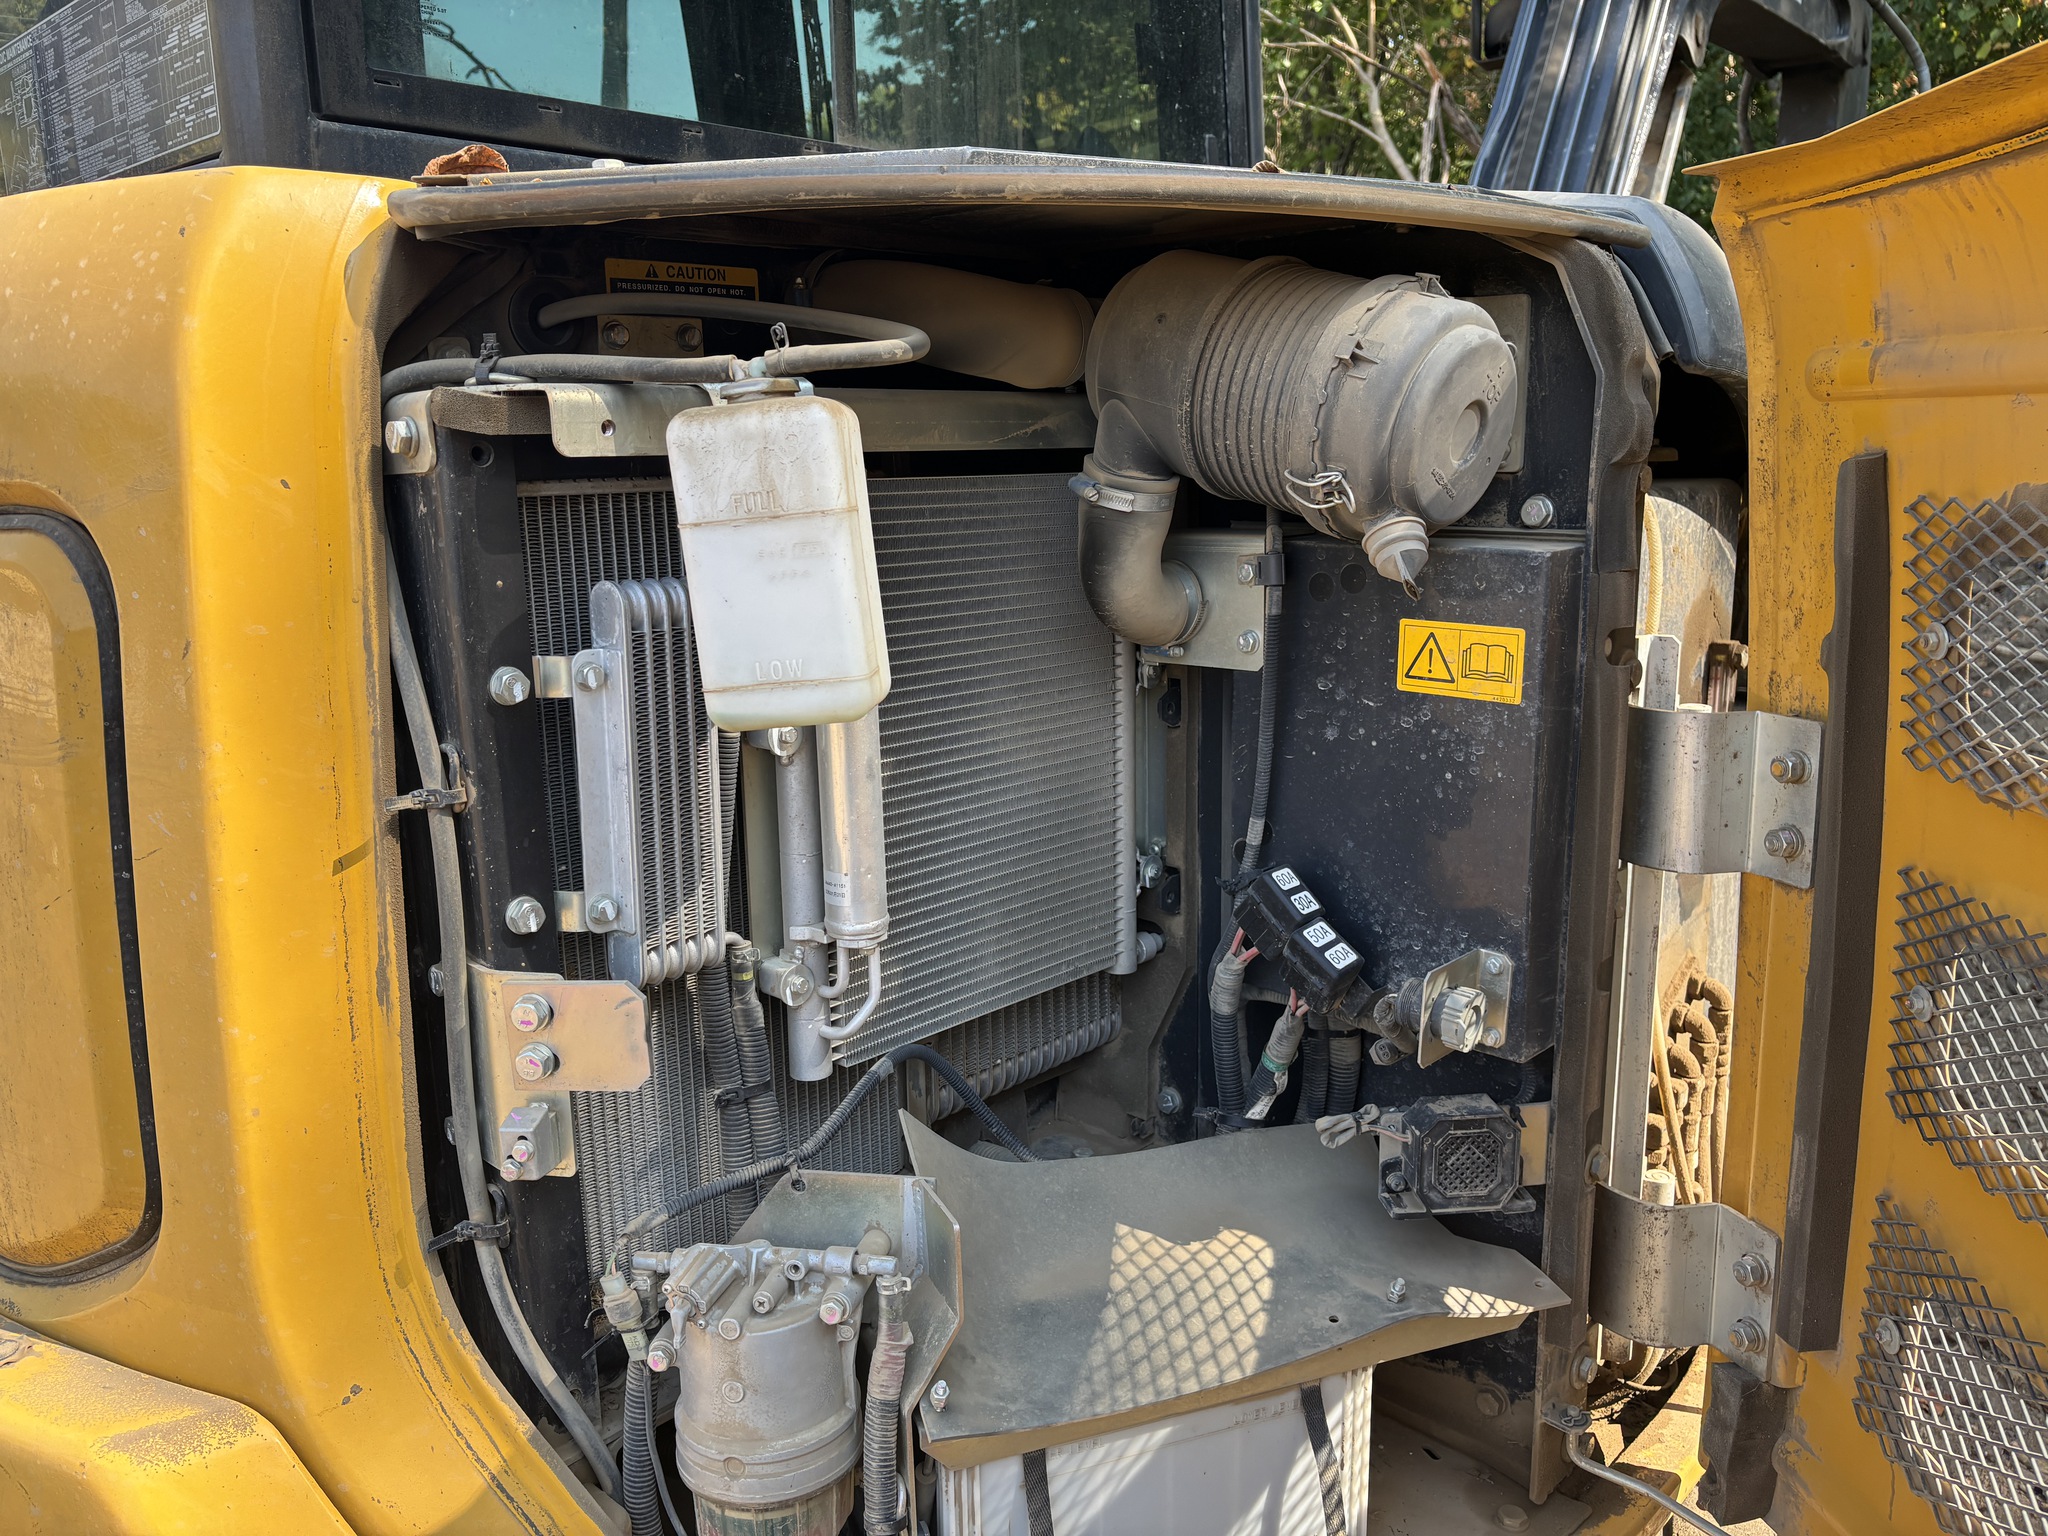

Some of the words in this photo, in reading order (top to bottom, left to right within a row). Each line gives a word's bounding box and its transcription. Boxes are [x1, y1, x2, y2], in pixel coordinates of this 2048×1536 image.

[666, 264, 726, 282] CAUTION
[617, 282, 671, 292] PRESSURIZED.
[675, 285, 686, 293] DO
[689, 286, 703, 294] NOT
[707, 287, 726, 295] OPEN
[730, 288, 746, 296] HOT.
[730, 489, 783, 514] FULL
[754, 658, 804, 682] LOW
[1275, 870, 1298, 886] 60A
[1293, 893, 1317, 911] 30A
[1306, 925, 1332, 943] 50A
[1328, 945, 1354, 965] 60A
